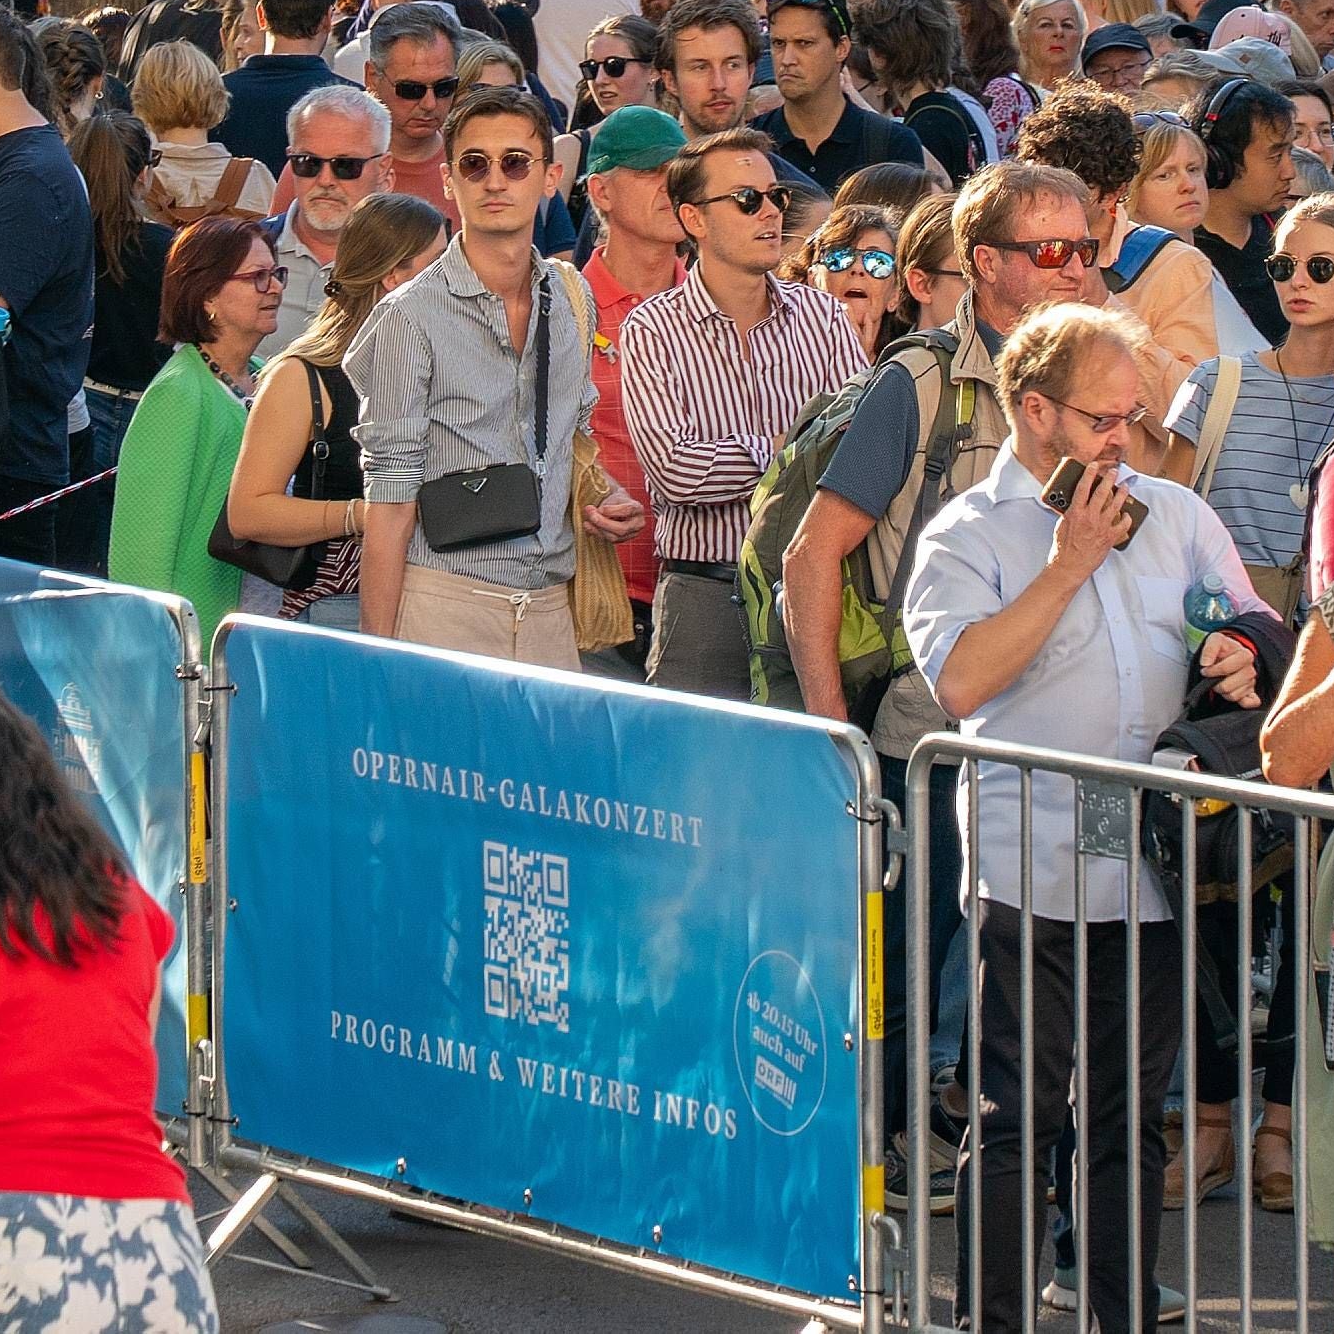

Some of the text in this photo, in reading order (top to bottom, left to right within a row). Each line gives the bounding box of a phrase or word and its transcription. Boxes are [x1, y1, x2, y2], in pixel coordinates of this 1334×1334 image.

[352, 747, 702, 848] OPERNAIR-GALAKONZERT
[746, 991, 818, 1056] ab 20.15 Uhr
[752, 1025, 807, 1073] auch auf
[330, 1010, 478, 1075] PROGRAMM
[489, 1050, 505, 1082] &
[517, 1056, 641, 1117] WEITERE
[654, 1090, 738, 1140] INFOS
